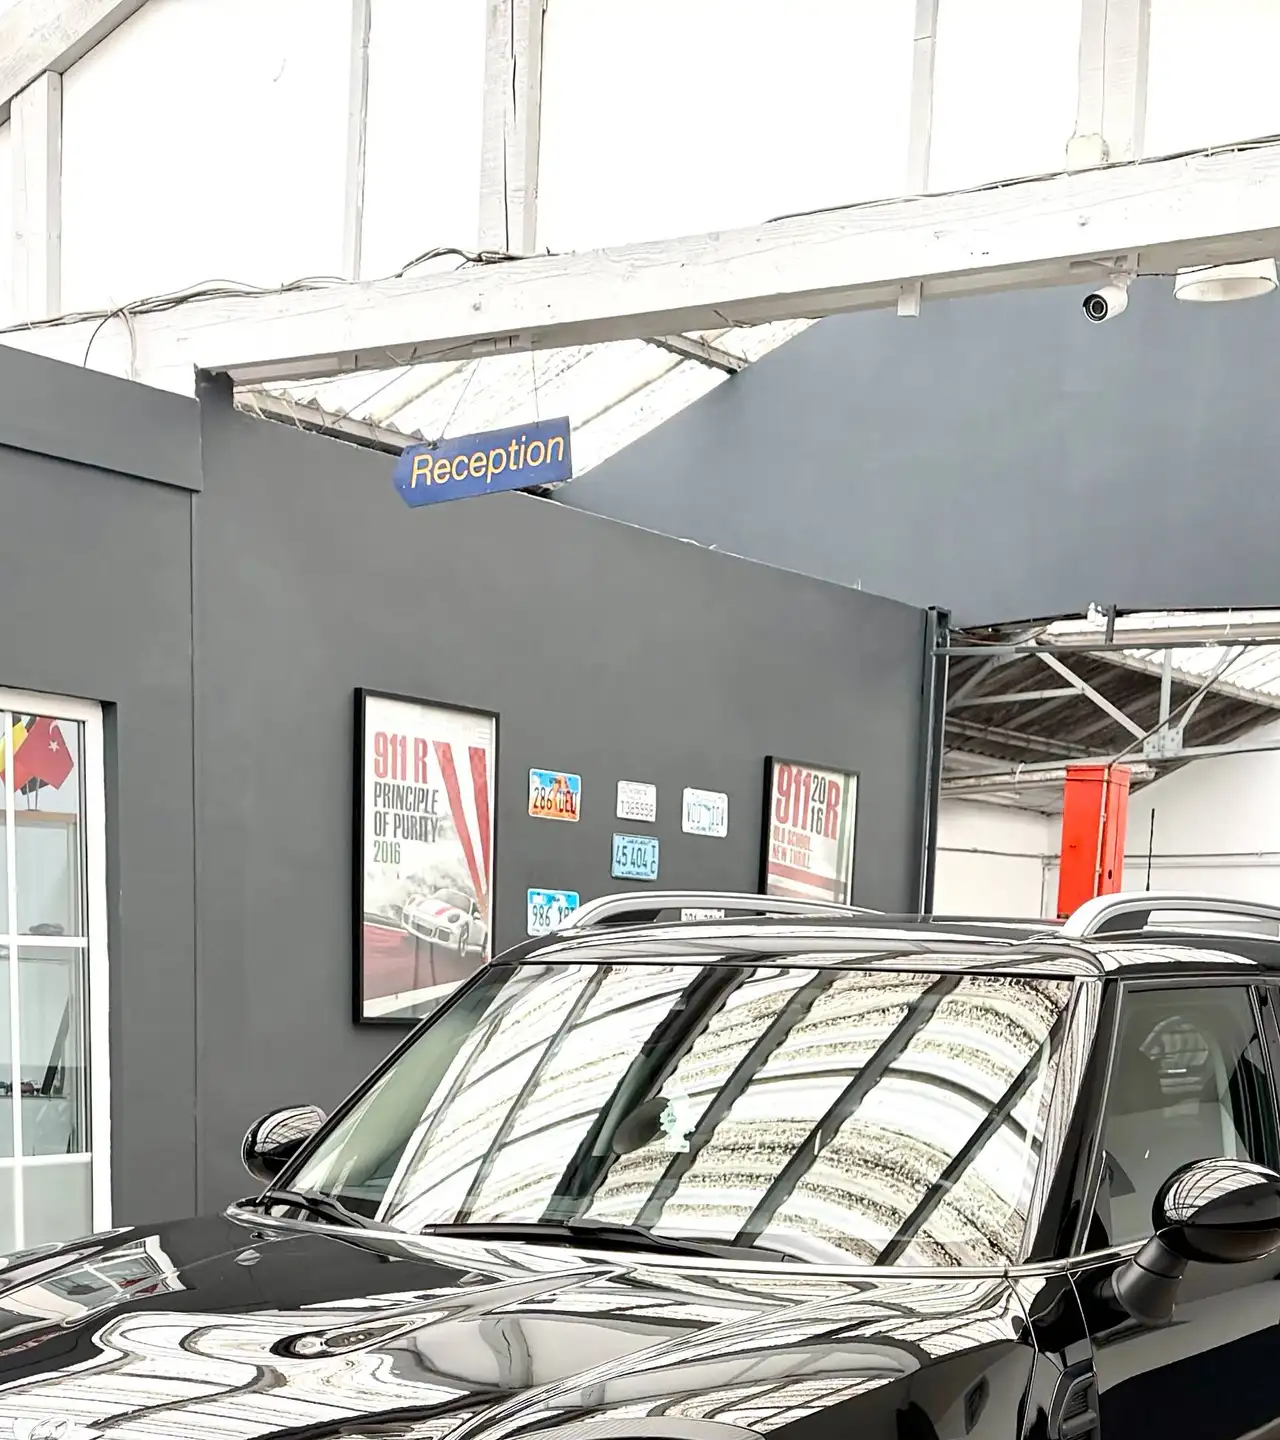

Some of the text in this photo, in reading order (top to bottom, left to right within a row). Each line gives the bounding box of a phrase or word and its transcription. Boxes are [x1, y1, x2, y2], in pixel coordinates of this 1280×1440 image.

[410, 434, 565, 489] Reception
[373, 731, 428, 784] 911 R
[373, 781, 439, 816] PRINCIPLE
[533, 786, 553, 811] 286
[774, 763, 841, 841] 911 R
[373, 810, 439, 843] OF PURITY
[373, 839, 401, 865] 2016
[616, 844, 628, 867] 45
[630, 846, 648, 869] 404
[532, 904, 551, 927] 986
